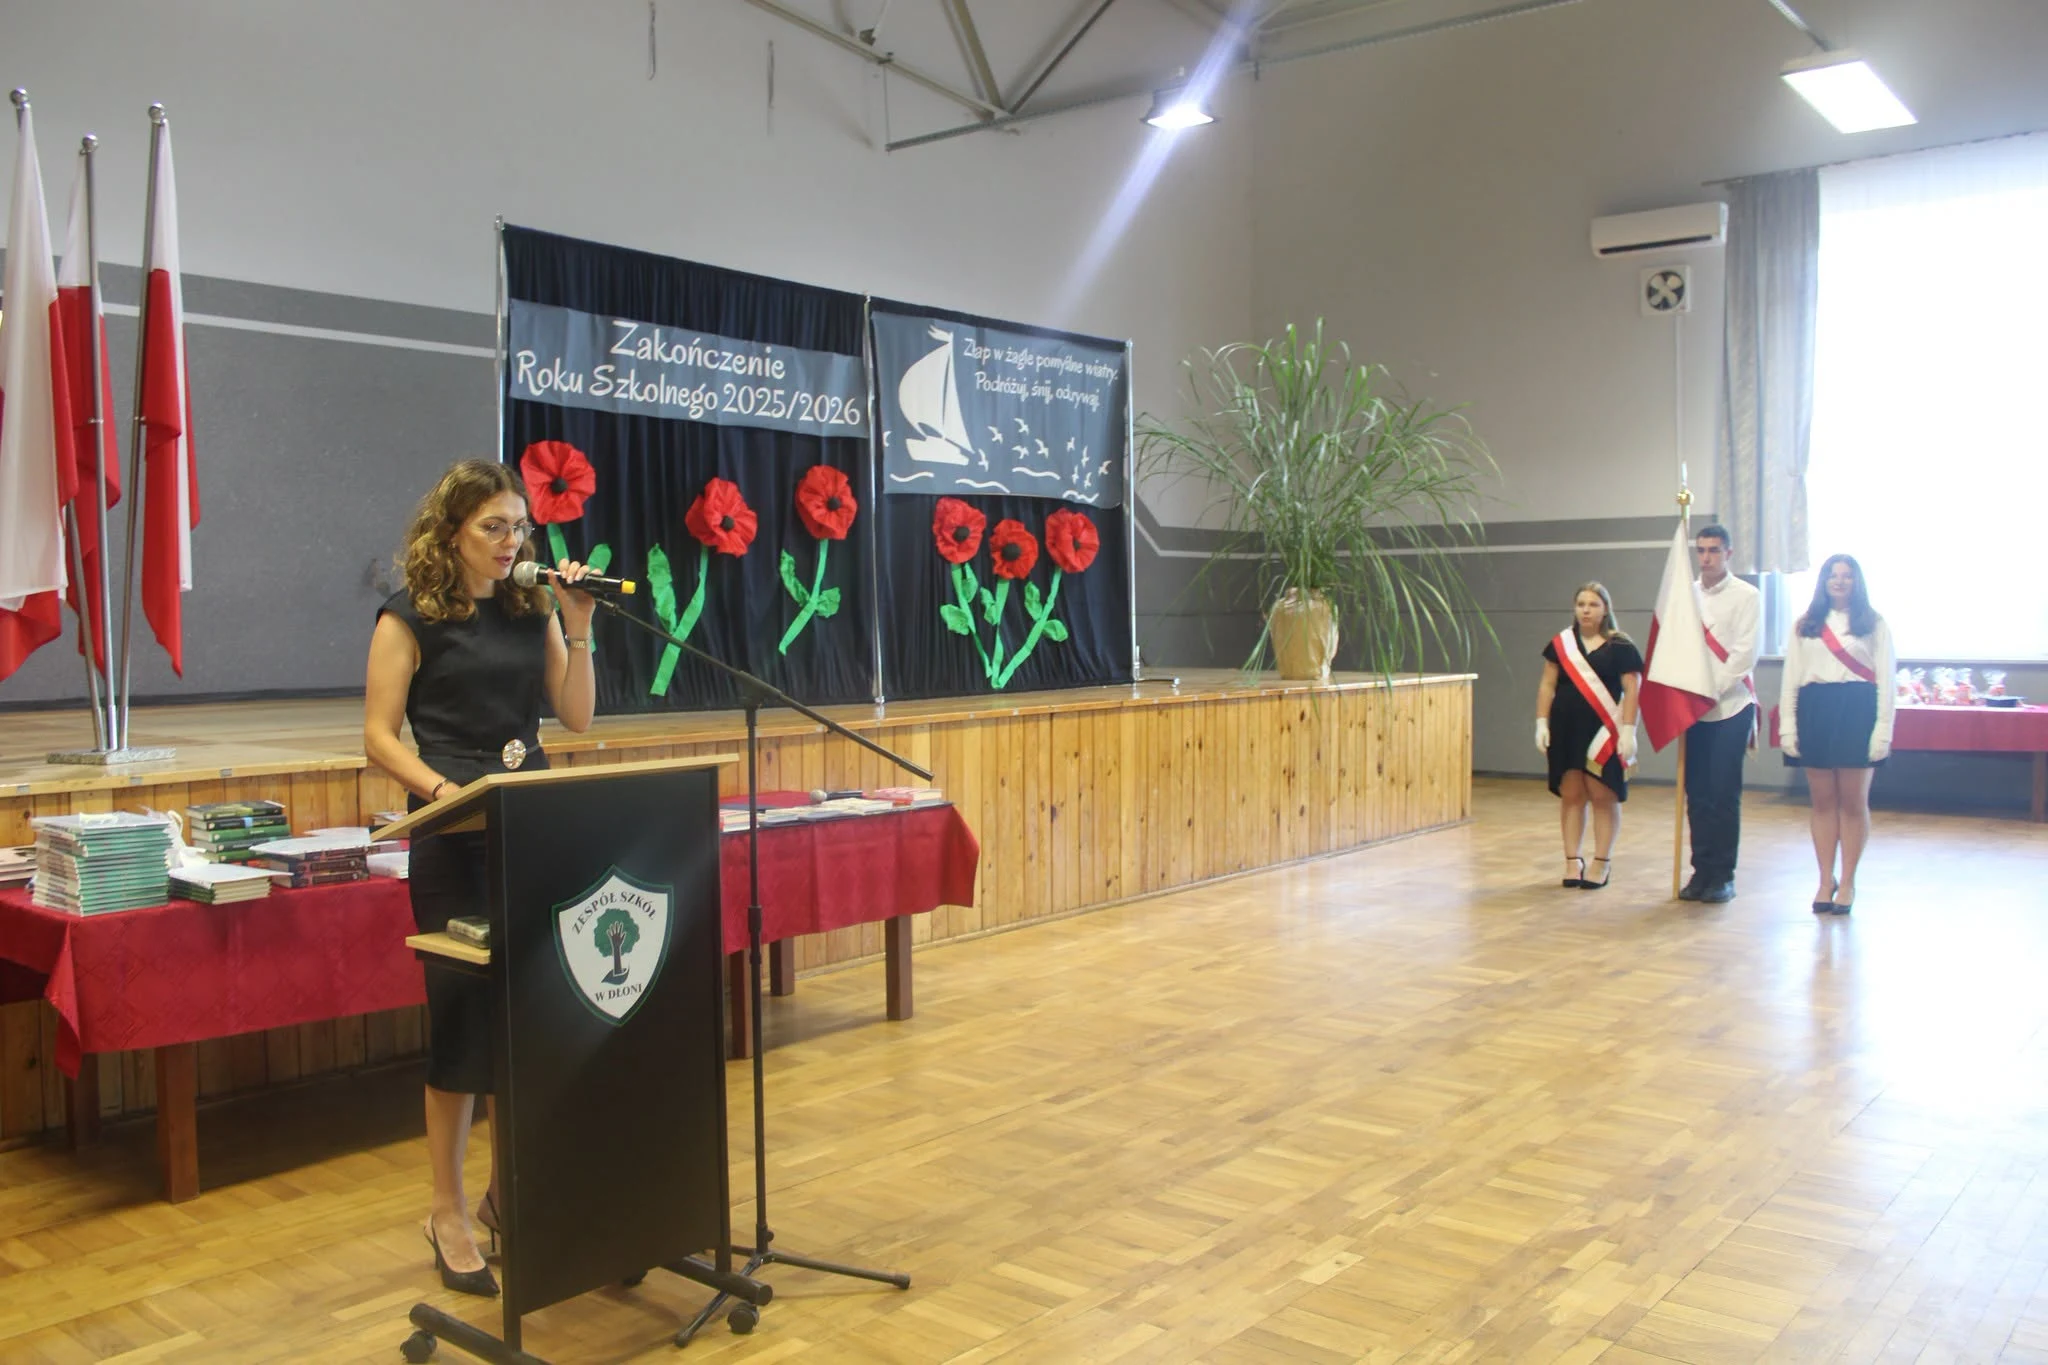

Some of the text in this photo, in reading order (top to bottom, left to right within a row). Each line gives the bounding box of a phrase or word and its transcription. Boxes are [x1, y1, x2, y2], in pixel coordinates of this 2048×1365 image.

[610, 320, 786, 380] Zakończenie
[994, 349, 1004, 361] w
[516, 350, 861, 426] Roku Szkolnego 2025/2026
[974, 371, 1029, 402] Podróżuj,
[572, 891, 658, 935] ZESPÓŁ SZKÓŁ
[594, 983, 643, 1002] W DŁONI
